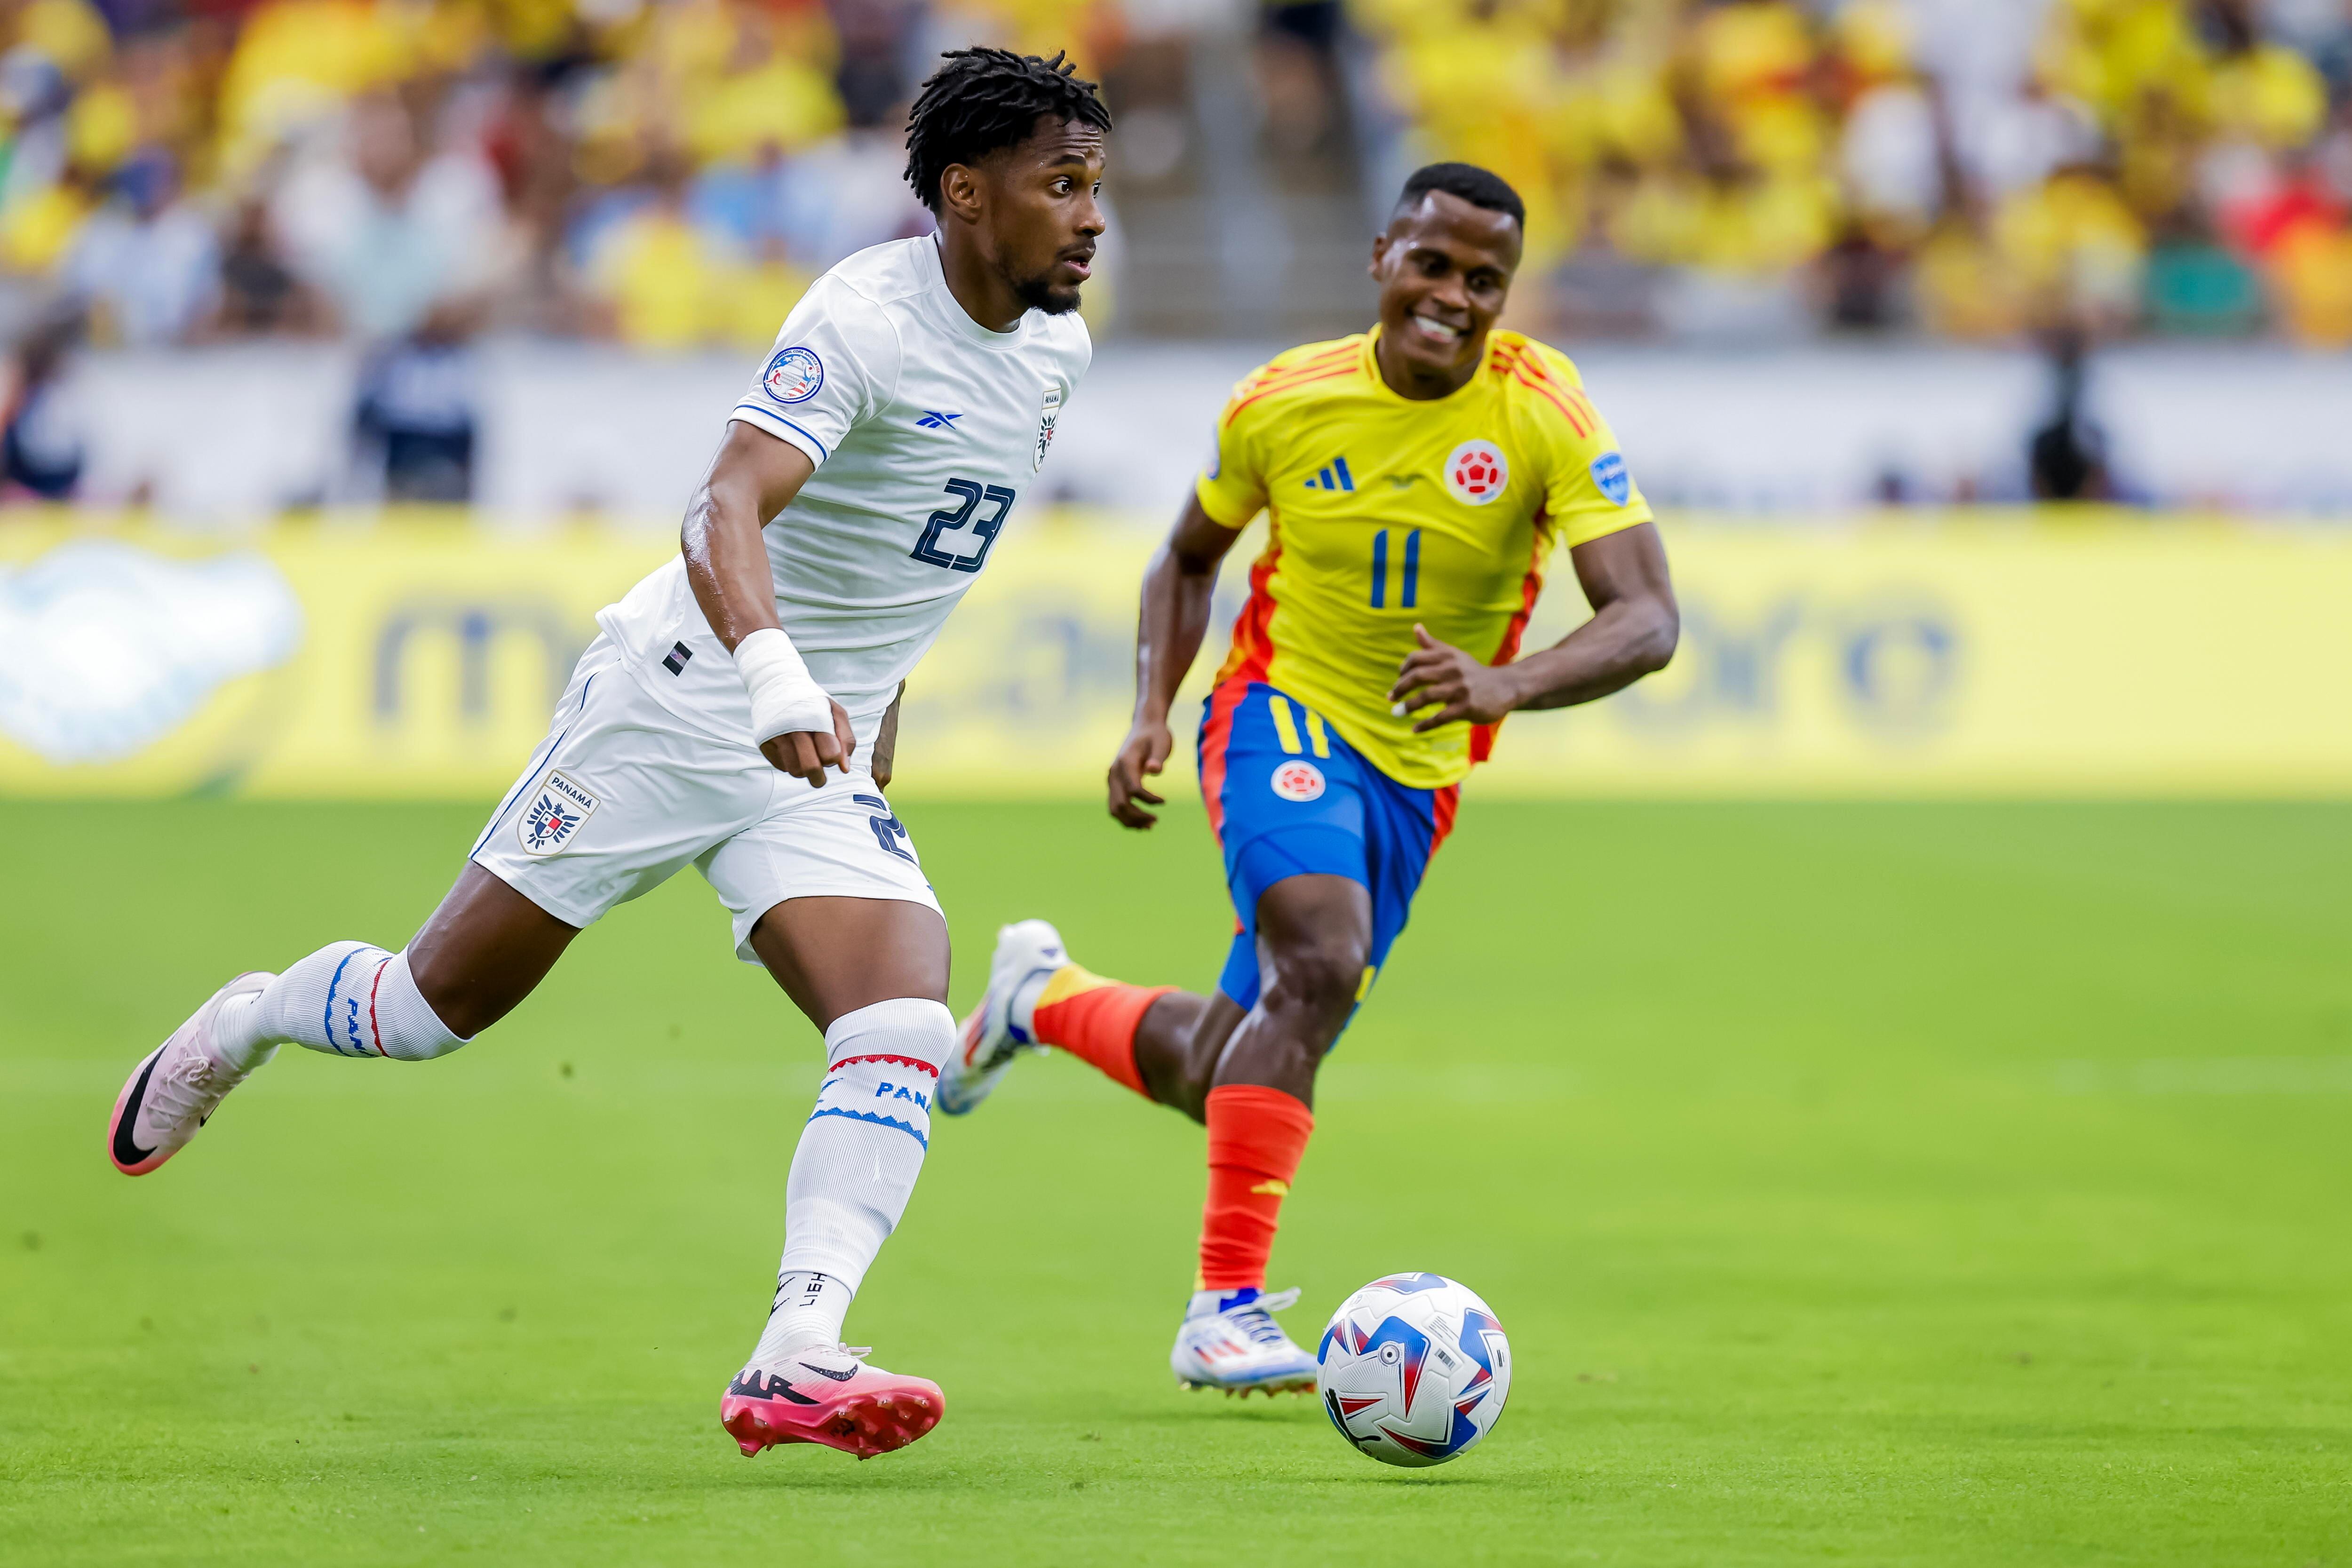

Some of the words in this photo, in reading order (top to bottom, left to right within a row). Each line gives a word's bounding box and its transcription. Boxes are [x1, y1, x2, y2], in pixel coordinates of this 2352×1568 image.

[908, 478, 1016, 573] 23
[1370, 529, 1420, 608] 11
[1269, 696, 1330, 759] 11
[551, 777, 593, 809] PANAMÁ
